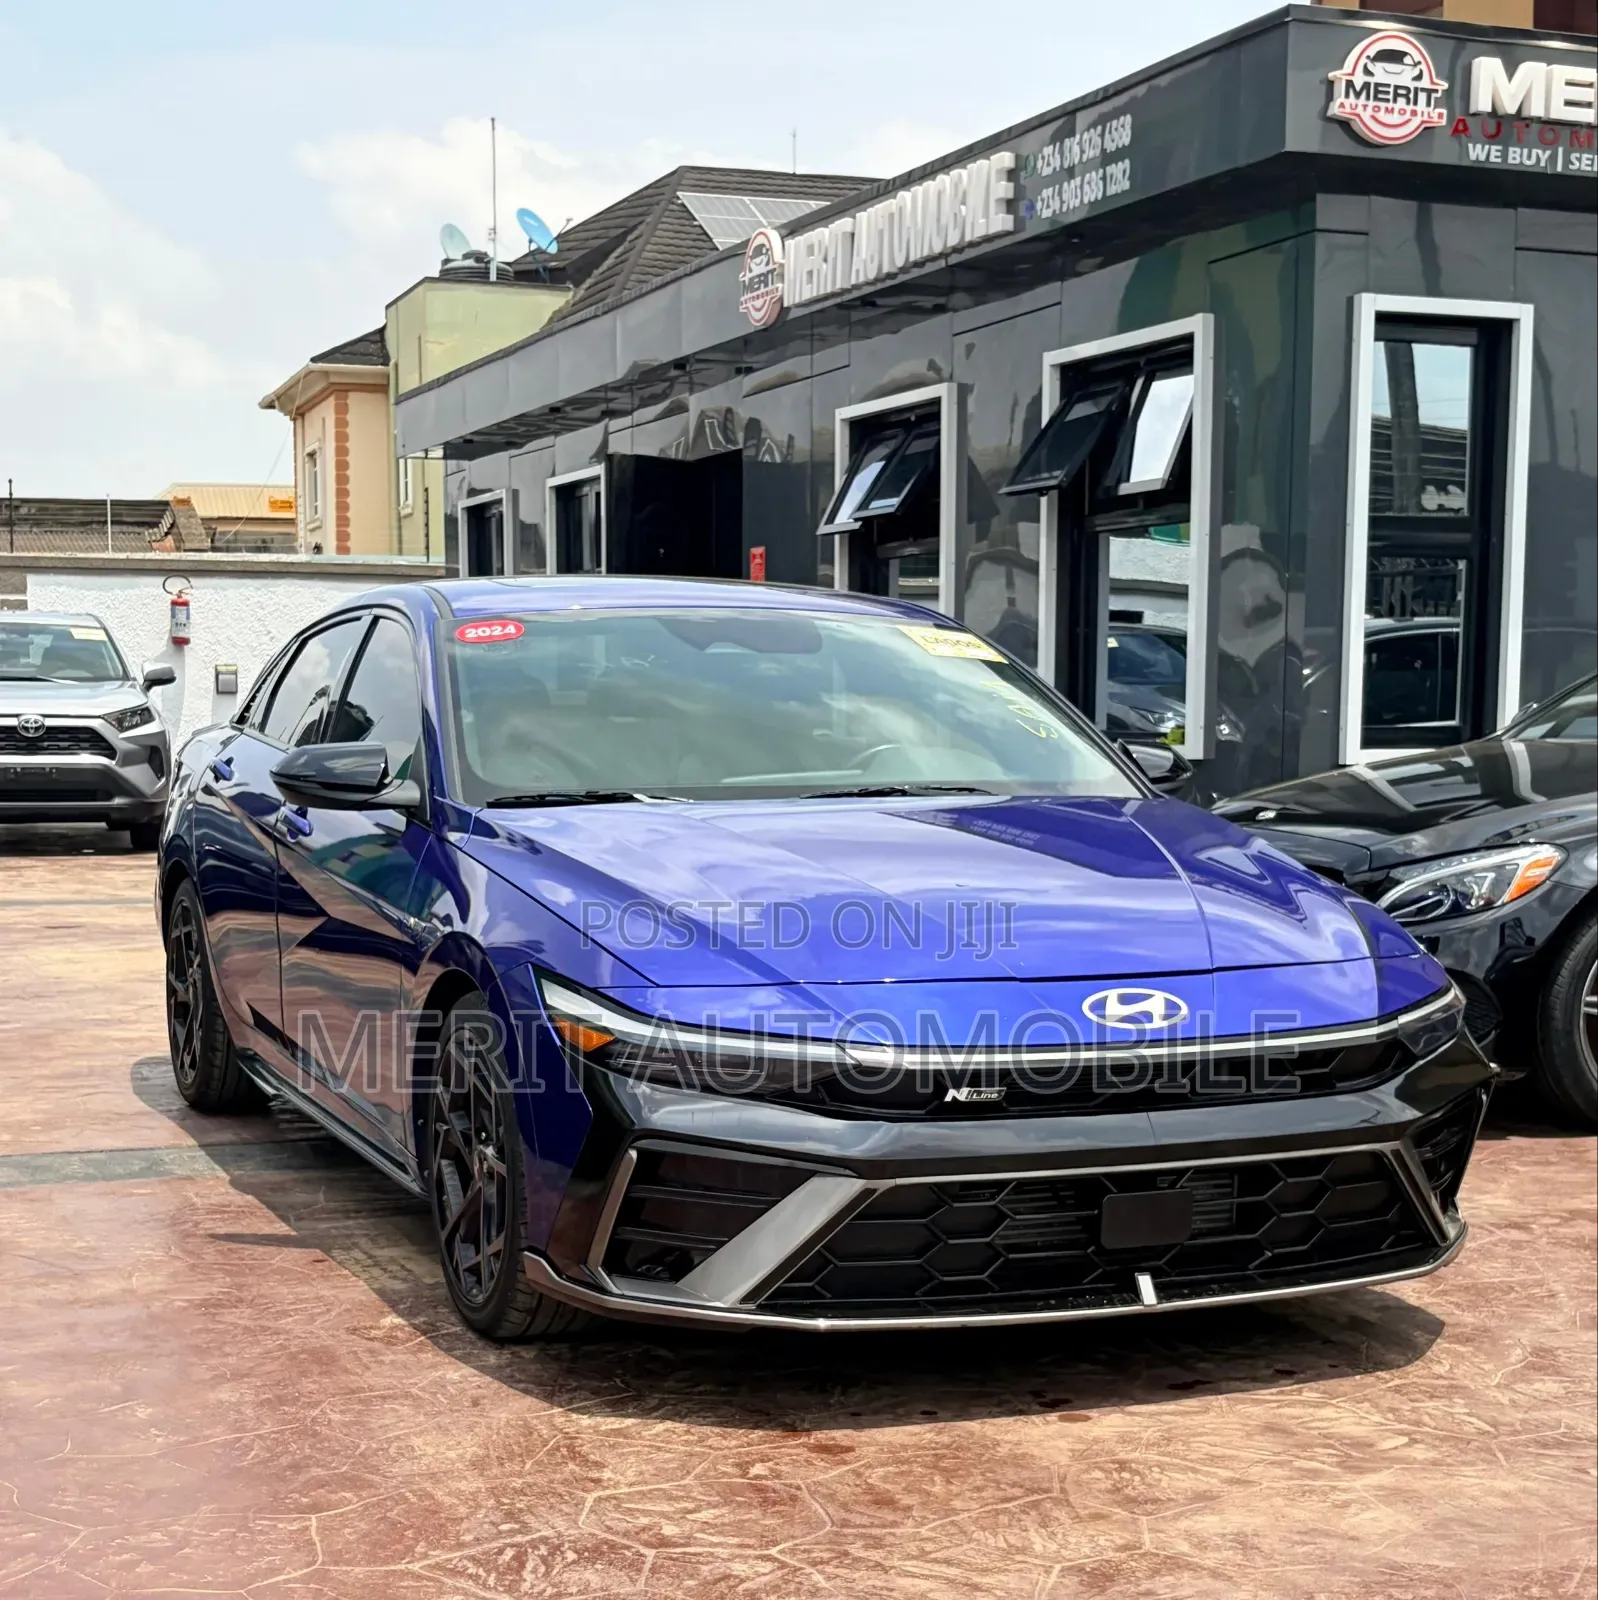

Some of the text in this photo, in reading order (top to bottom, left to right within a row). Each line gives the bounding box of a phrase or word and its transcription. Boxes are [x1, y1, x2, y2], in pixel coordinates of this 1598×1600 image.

[1344, 78, 1439, 108] MERIT
[1338, 101, 1445, 121] AUTOMOBILE
[1036, 114, 1132, 177] +234 816 926 4568
[1451, 117, 1594, 148] AUTOM
[1468, 143, 1502, 164] WE
[1508, 146, 1551, 167] BUY
[1036, 185, 1060, 219] +234
[1061, 176, 1081, 213] 903
[1105, 158, 1131, 197] 1282
[851, 151, 1016, 285] AUTOMOBILE
[465, 625, 516, 638] 2024
[943, 1087, 999, 1102] N Line
